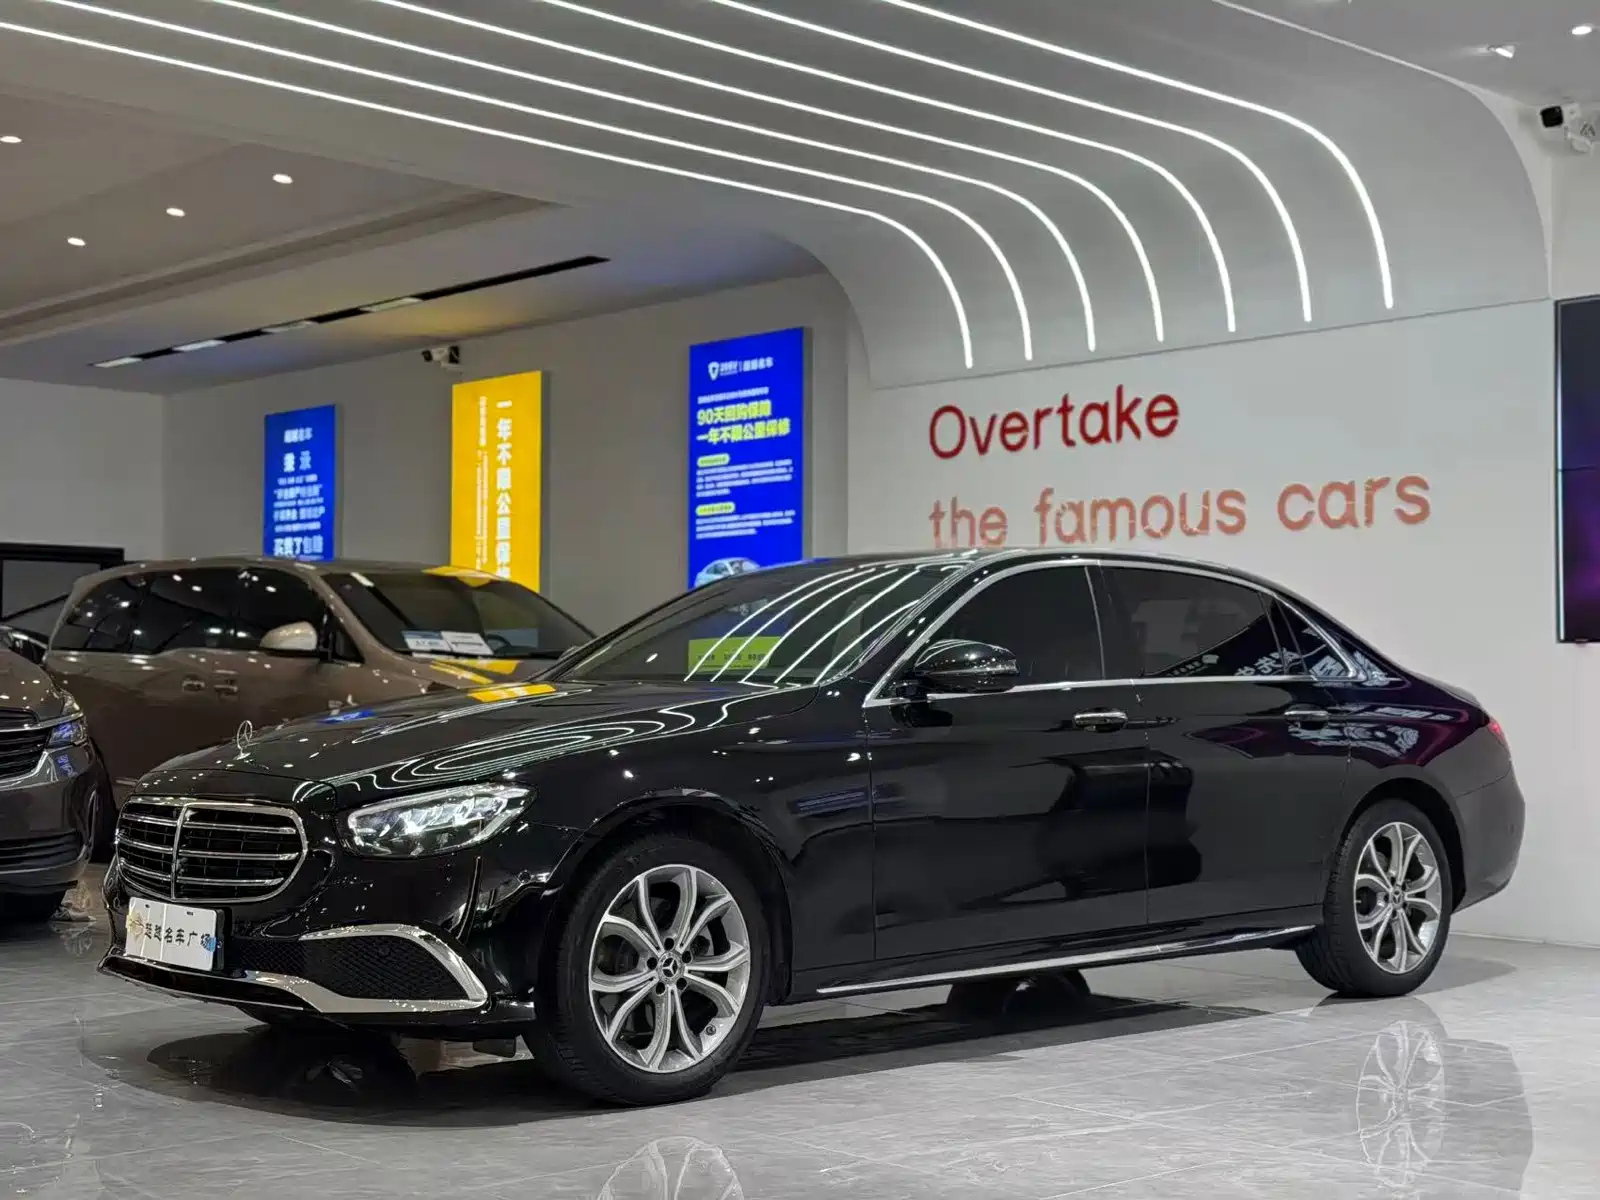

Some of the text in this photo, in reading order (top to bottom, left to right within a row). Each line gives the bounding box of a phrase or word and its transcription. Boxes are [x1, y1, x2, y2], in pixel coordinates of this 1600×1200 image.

[929, 384, 1180, 459] Overtake
[930, 473, 1432, 547] the famous cars
